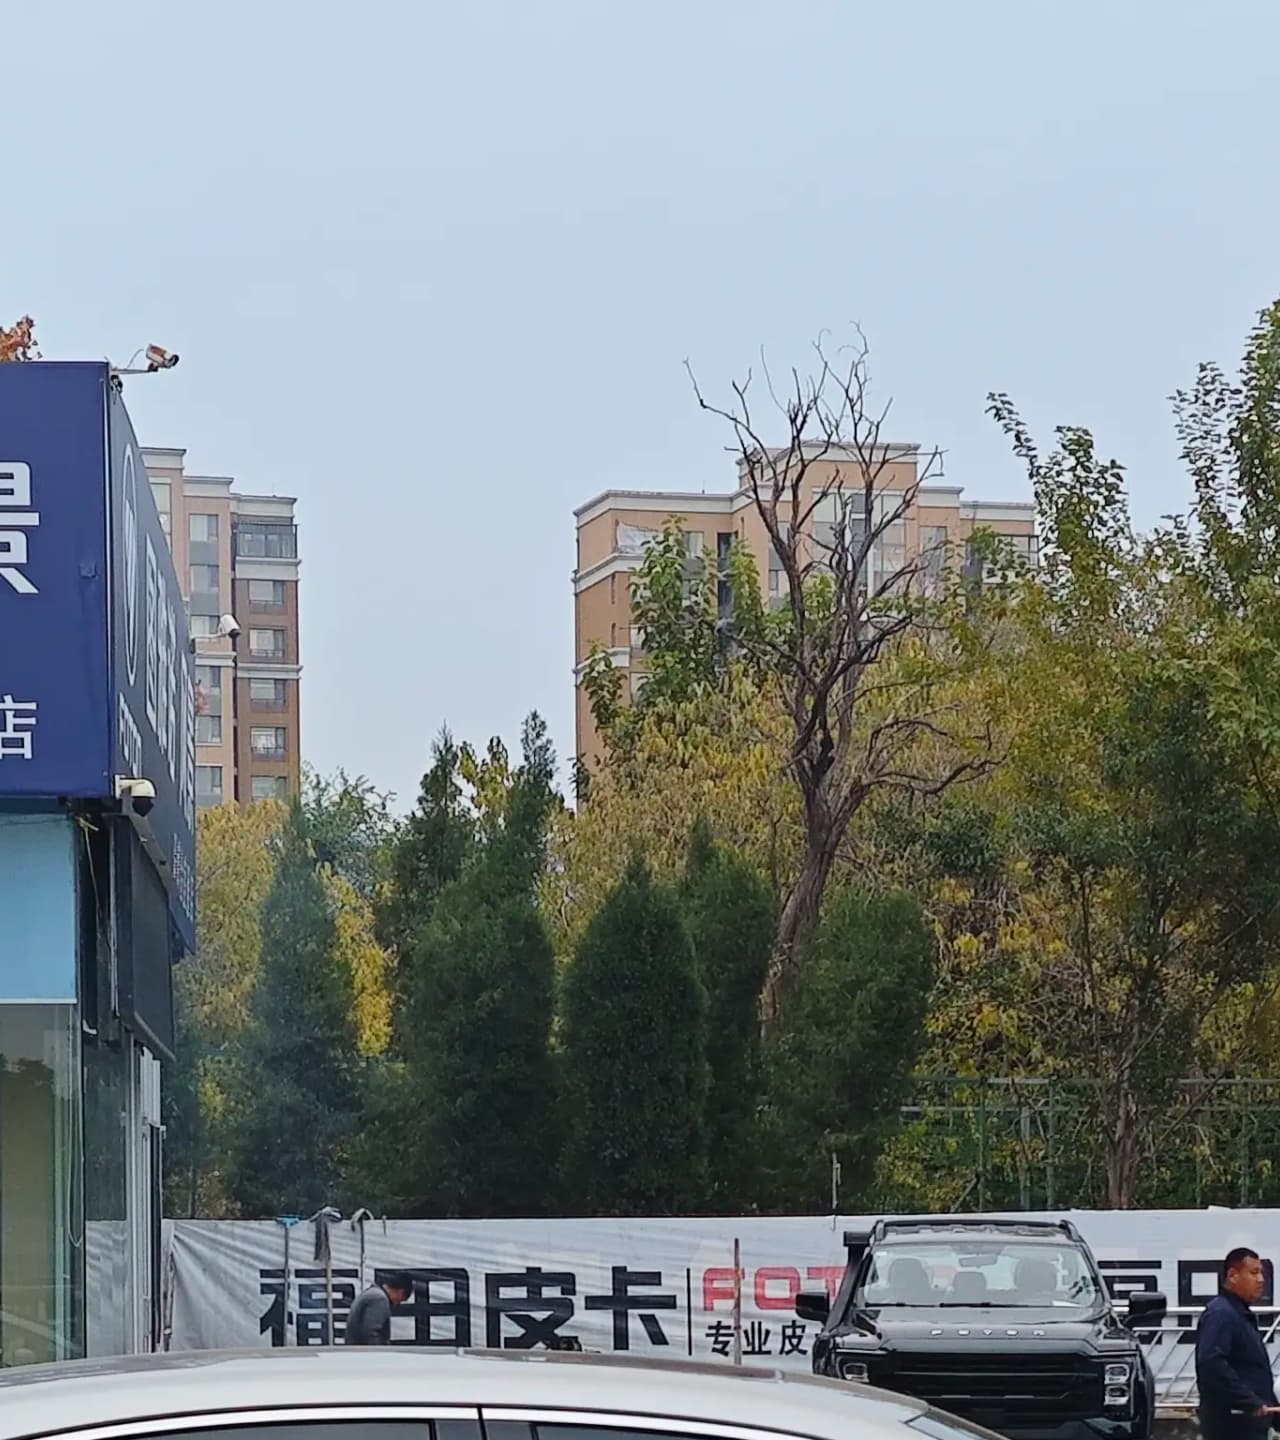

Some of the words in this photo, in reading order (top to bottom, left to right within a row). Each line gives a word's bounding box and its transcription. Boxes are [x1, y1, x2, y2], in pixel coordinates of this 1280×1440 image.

[259, 1265, 677, 1351] 福田皮卡
[703, 1256, 848, 1312] FOT
[705, 1319, 818, 1357] 专业皮
